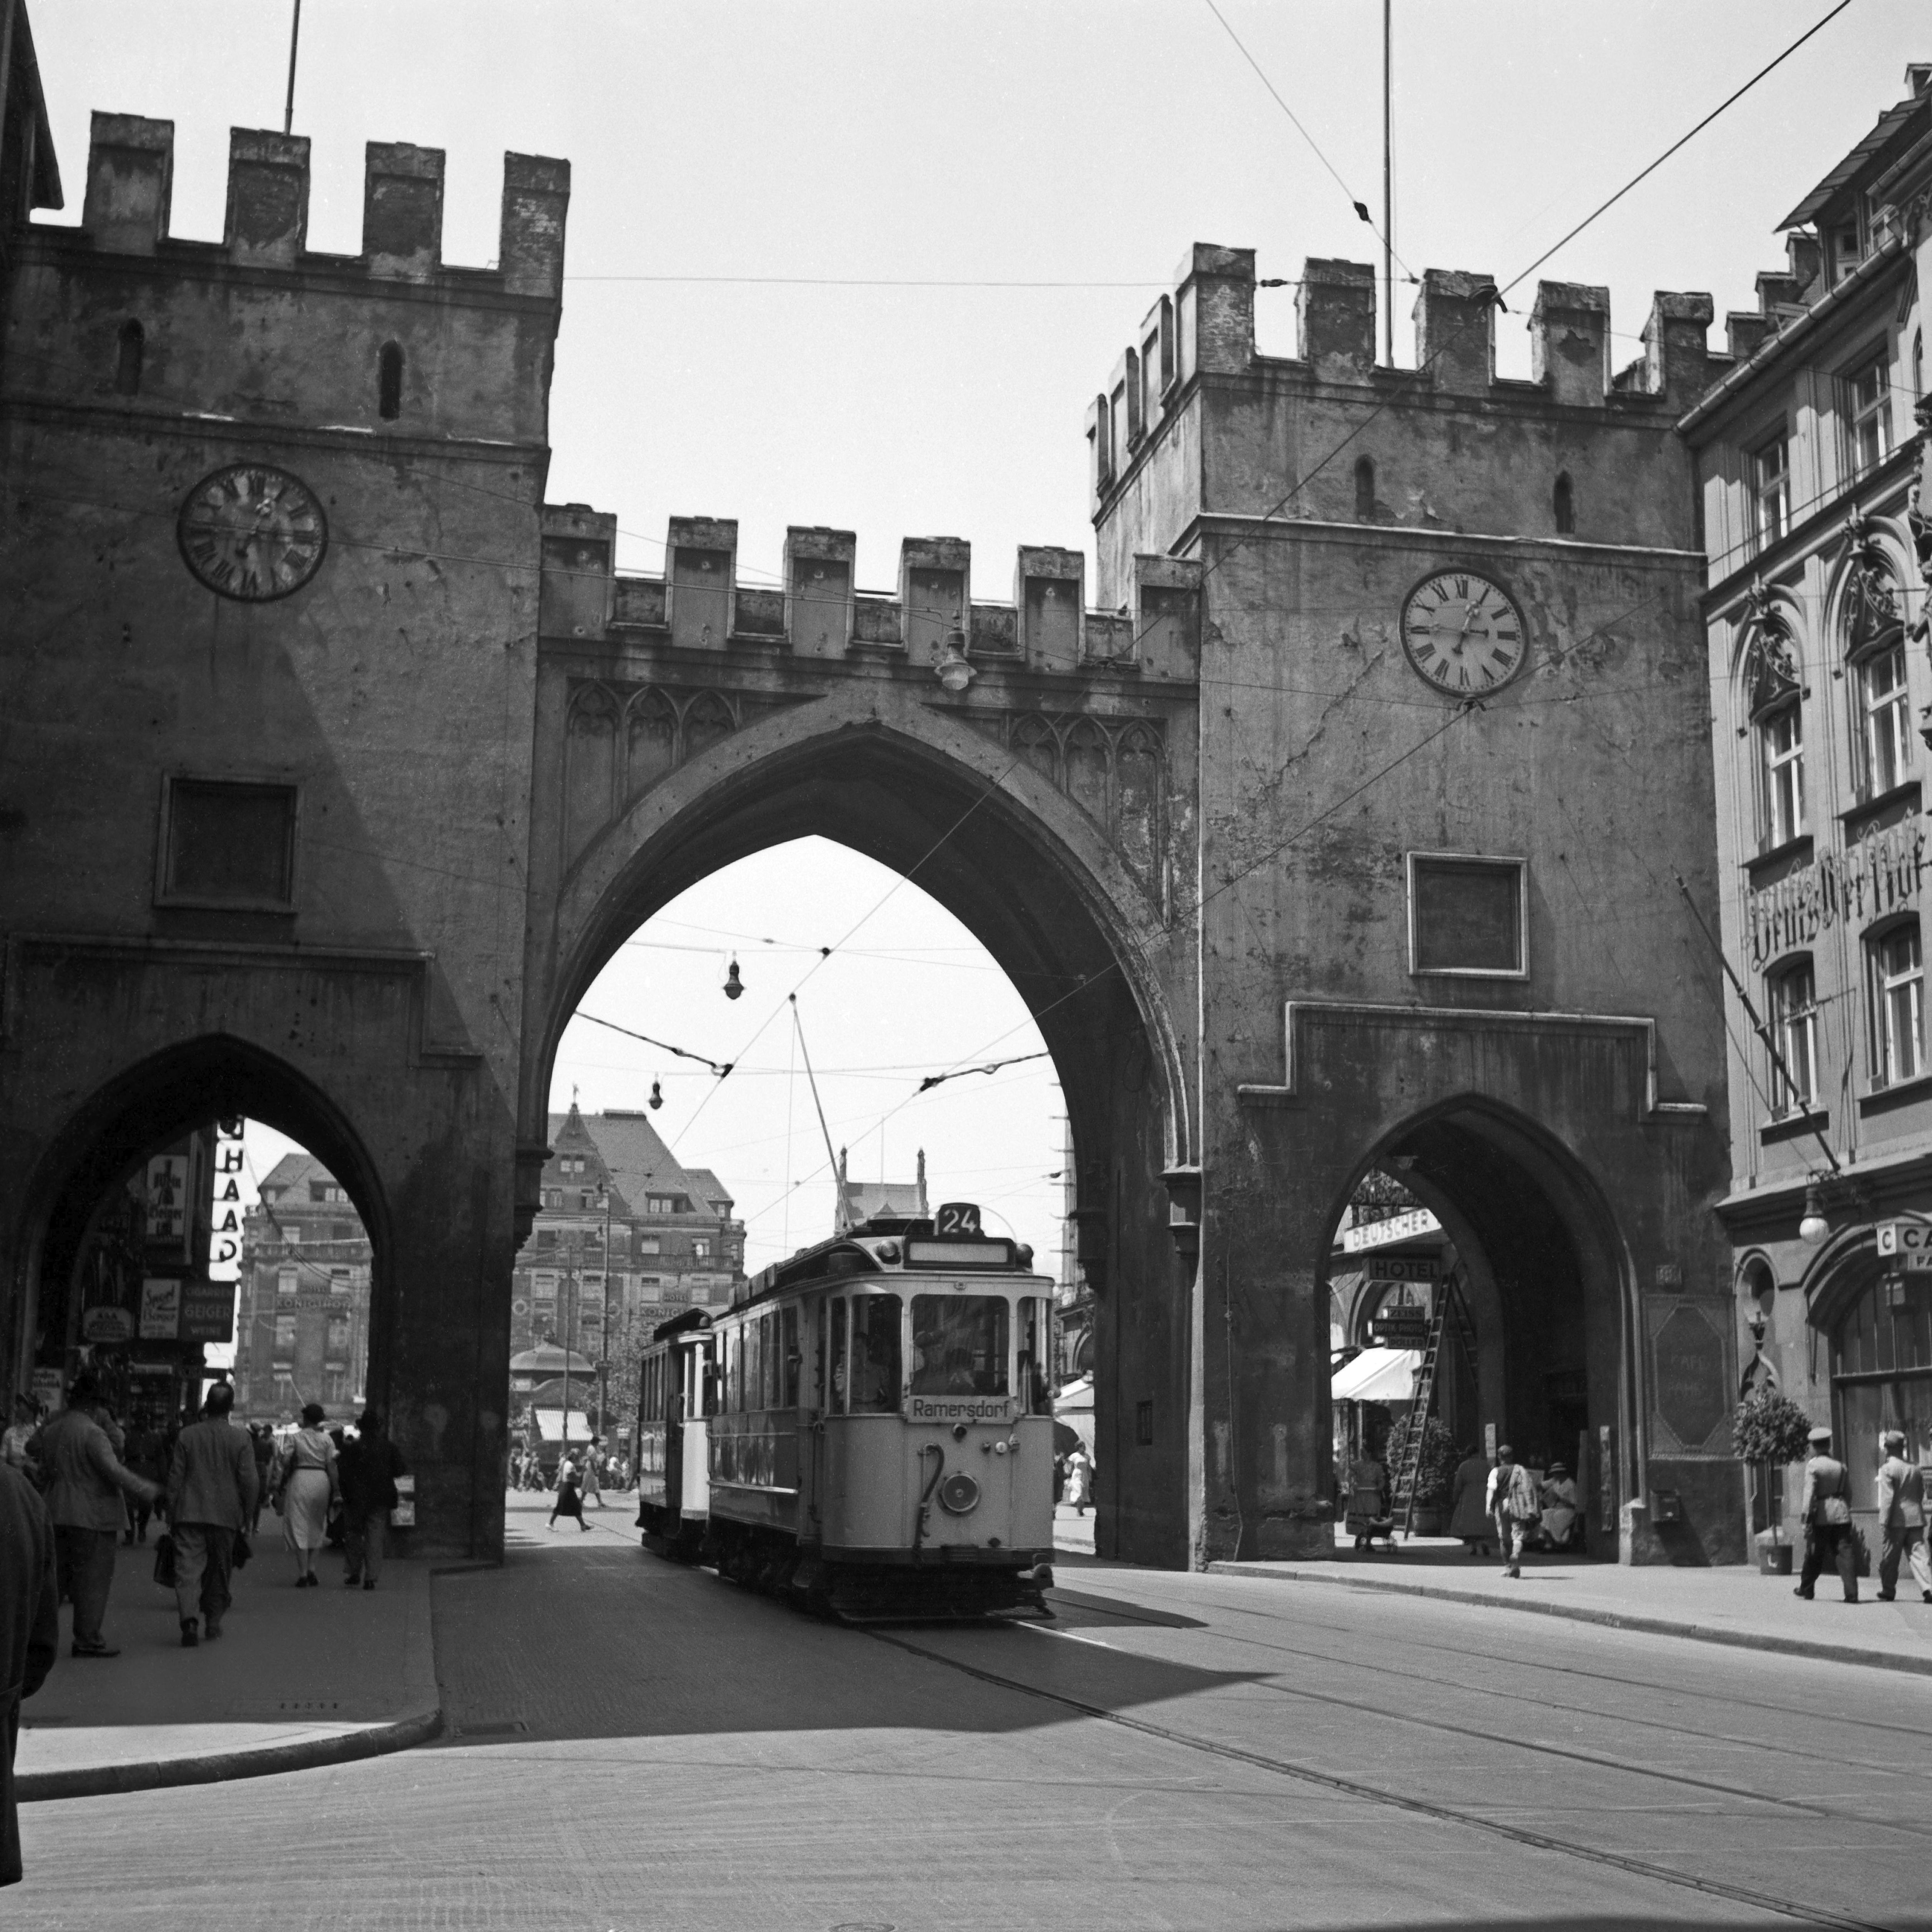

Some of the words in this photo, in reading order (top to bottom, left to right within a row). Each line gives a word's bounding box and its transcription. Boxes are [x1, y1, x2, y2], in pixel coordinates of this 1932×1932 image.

[942, 1209, 977, 1234] 24
[1352, 1210, 1429, 1248] DEUTSCHER
[1375, 1260, 1439, 1279] HOTEL
[1390, 1309, 1422, 1318] ZEISS
[1374, 1323, 1397, 1332] OPTIK
[914, 1399, 1010, 1418] Ramersdorf
